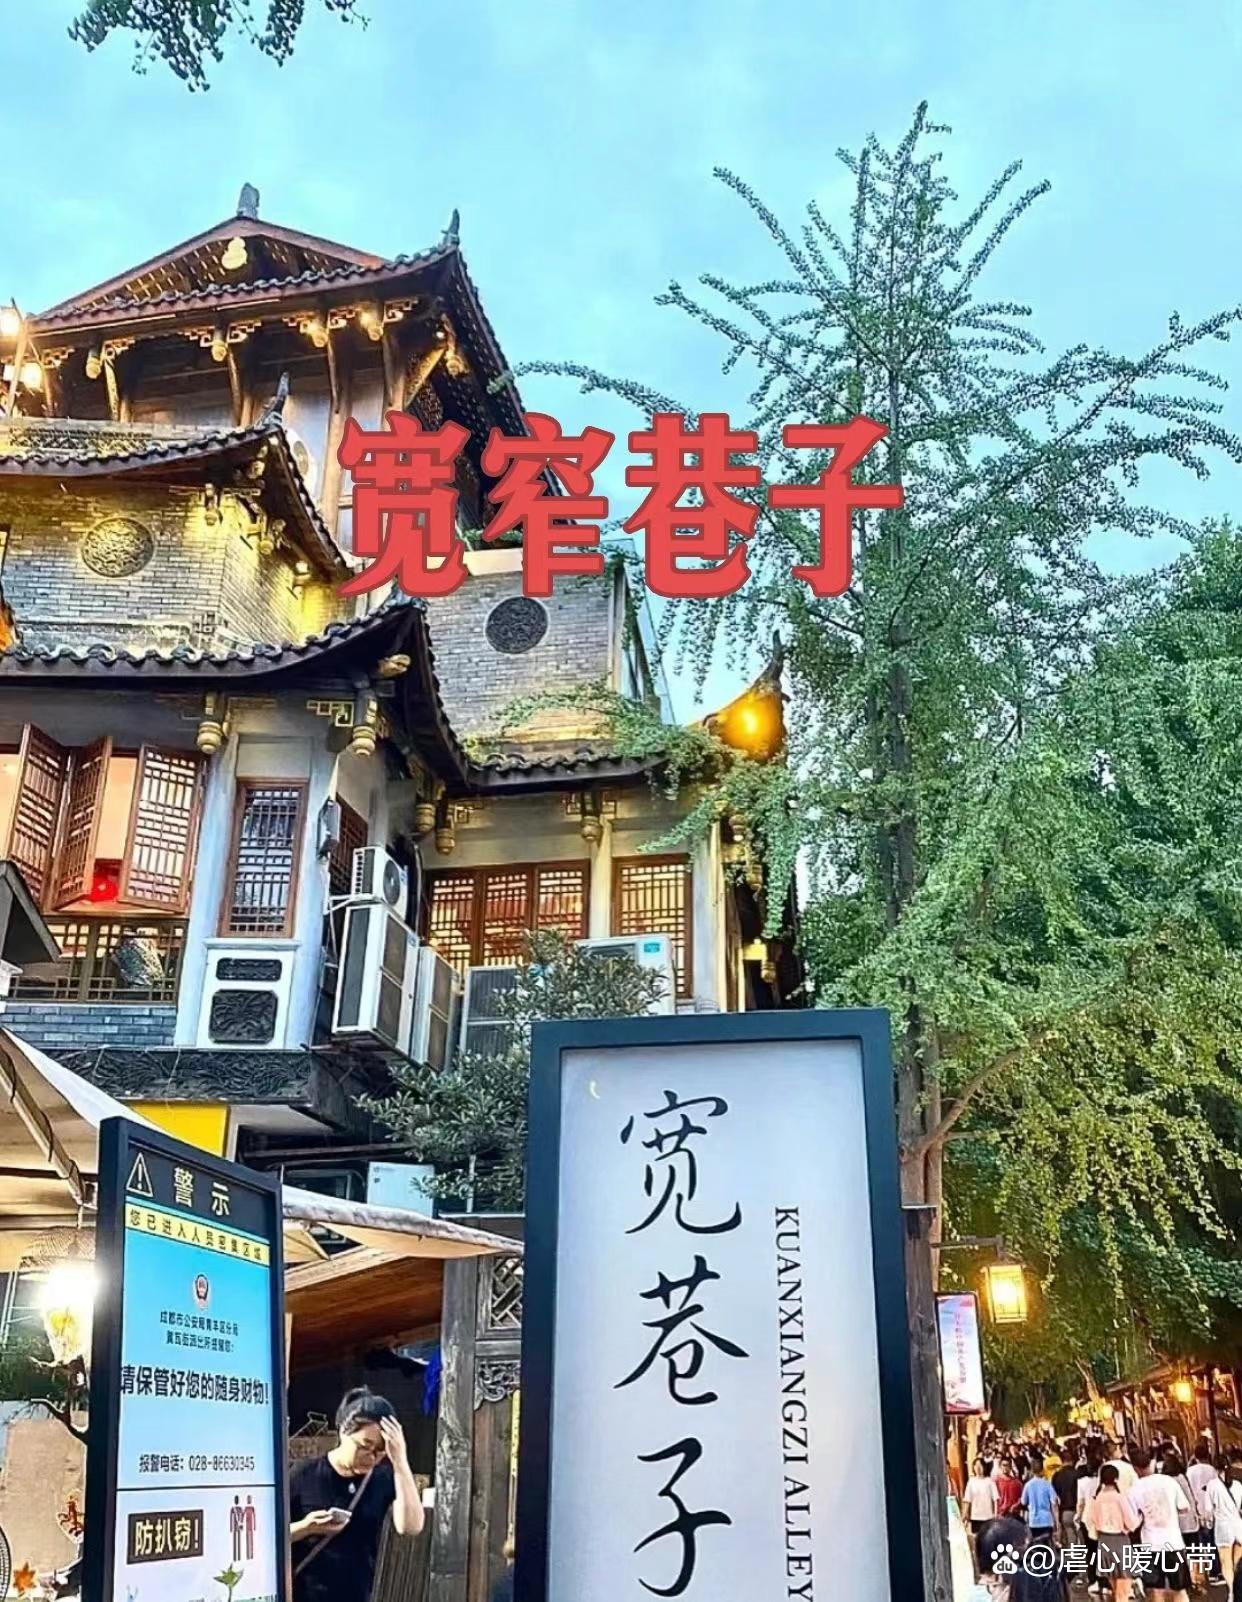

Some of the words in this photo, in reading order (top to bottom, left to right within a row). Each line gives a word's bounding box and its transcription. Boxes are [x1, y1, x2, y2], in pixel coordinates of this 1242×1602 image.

[173, 1166, 230, 1216] 警示
[614, 1090, 749, 1597] 宽巷子
[775, 1206, 809, 1464] KUANXIANGZI
[135, 1518, 199, 1556] 防扒窃!
[784, 1475, 814, 1602] ALLEY
